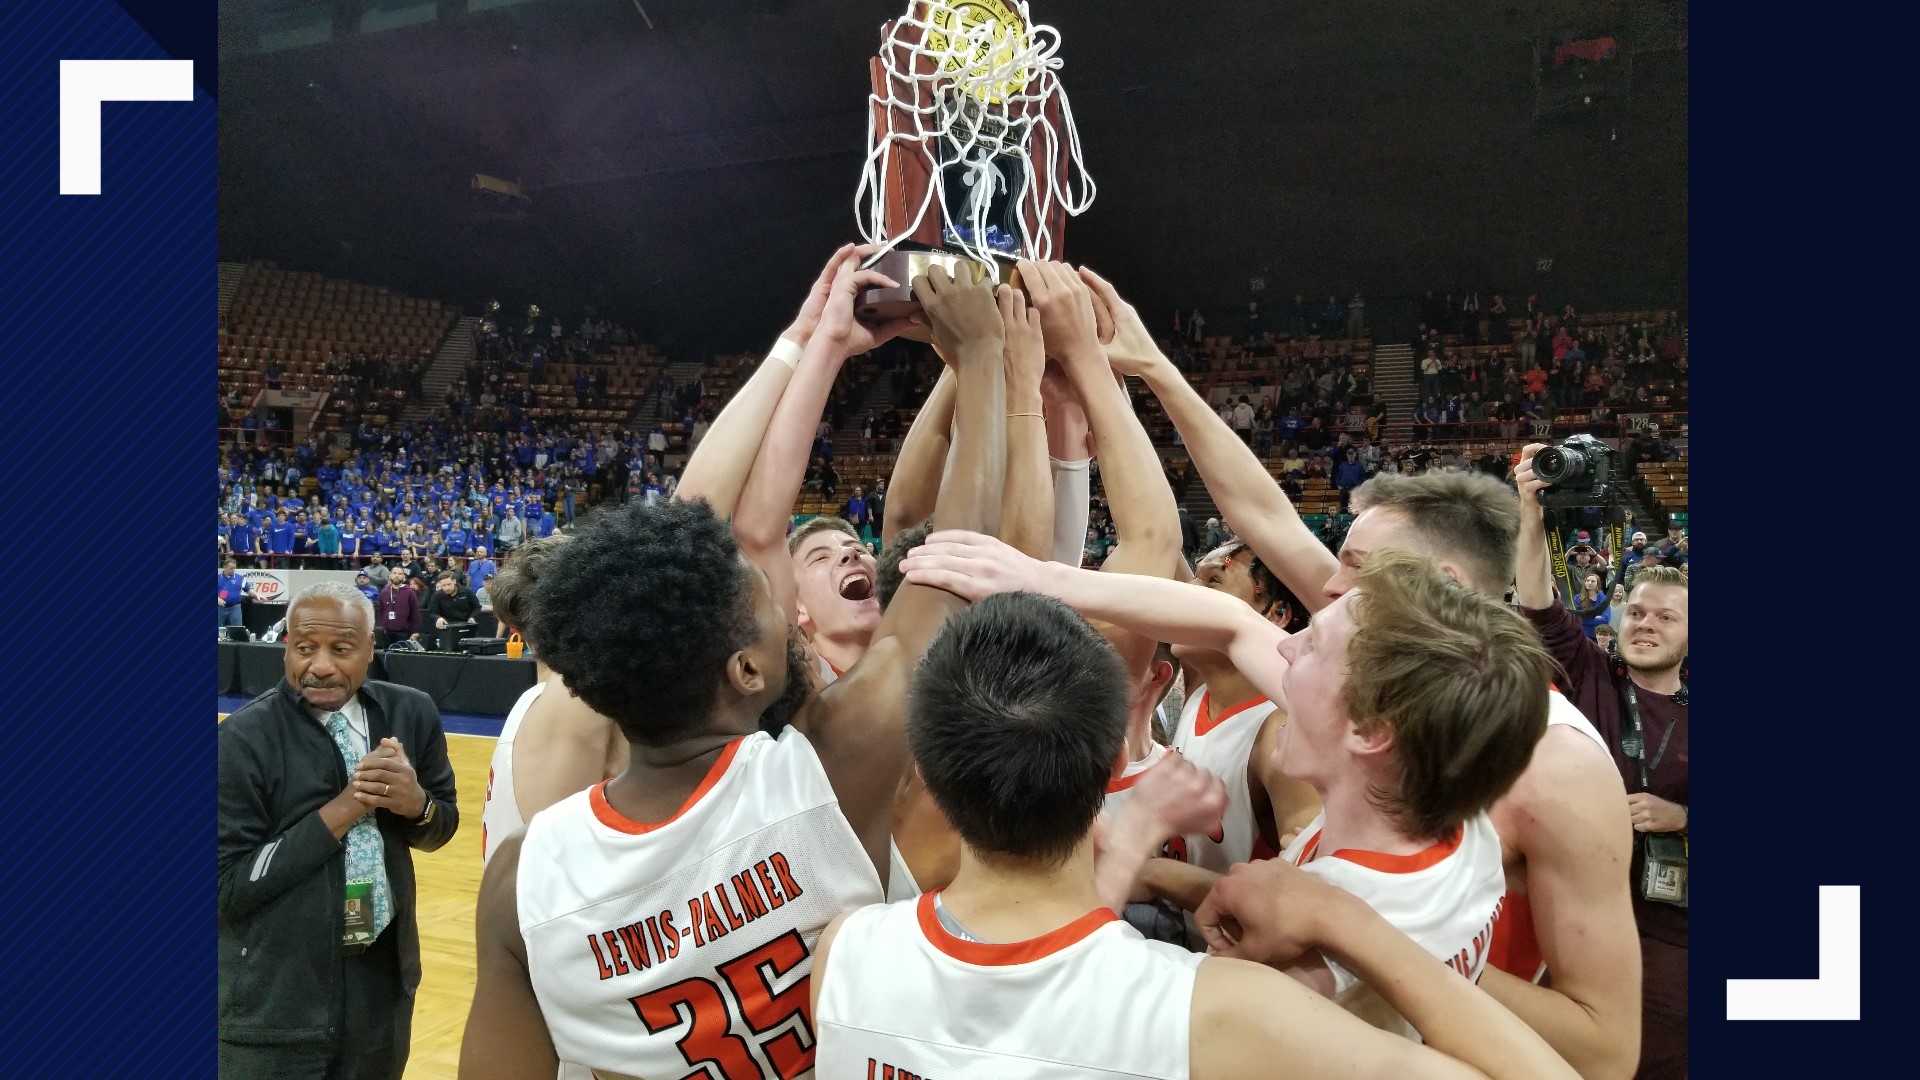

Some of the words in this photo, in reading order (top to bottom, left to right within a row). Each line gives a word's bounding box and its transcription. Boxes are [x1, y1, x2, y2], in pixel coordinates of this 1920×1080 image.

[1533, 424, 1551, 436] 127
[1630, 417, 1649, 430] 128
[1549, 530, 1559, 551] Nikon
[255, 582, 278, 593] 760
[588, 852, 803, 980] LEWIS-PALMER
[628, 927, 816, 1080] 35
